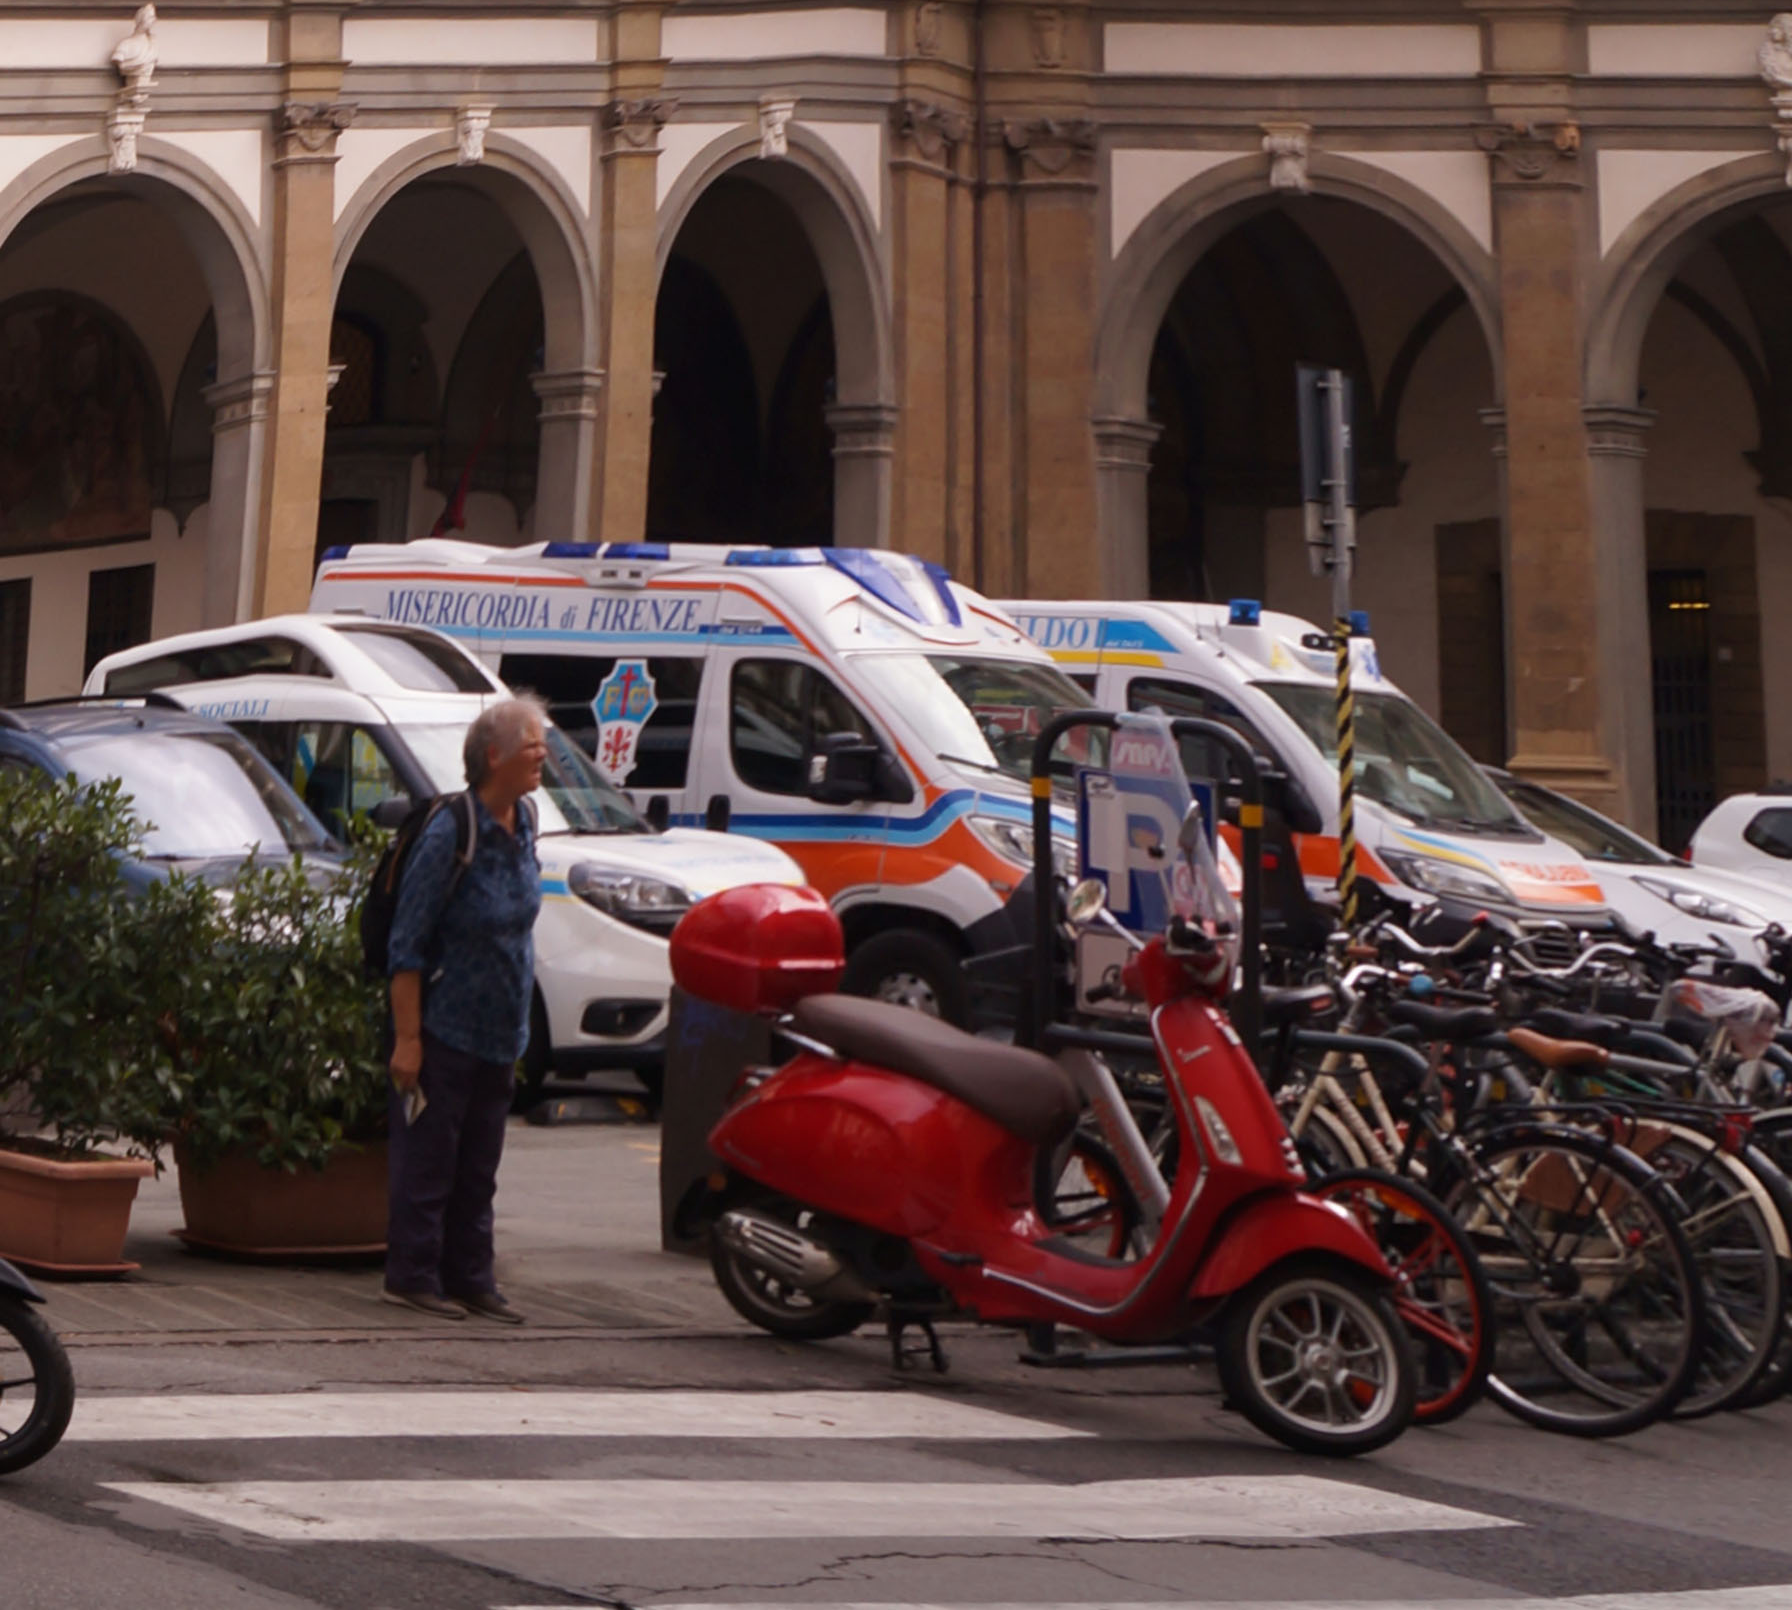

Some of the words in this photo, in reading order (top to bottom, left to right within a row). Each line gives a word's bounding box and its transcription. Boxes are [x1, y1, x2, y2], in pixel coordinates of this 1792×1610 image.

[385, 590, 550, 629] MISERICORDIA
[560, 605, 577, 629] di
[587, 597, 702, 633] FIRENZE
